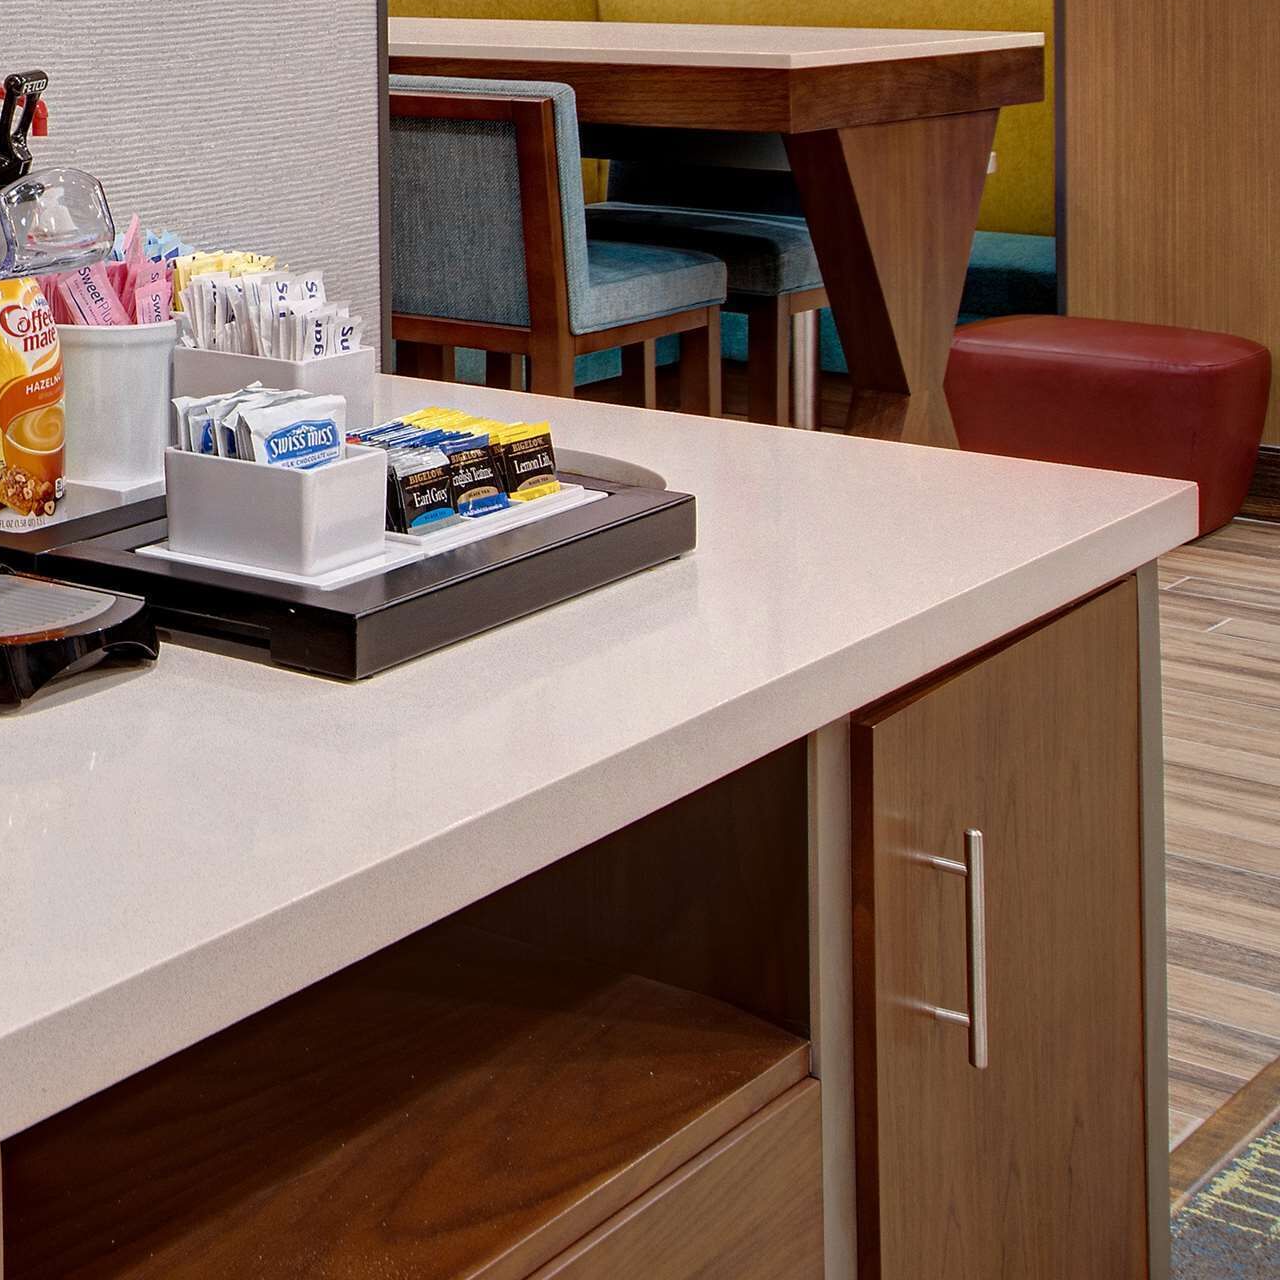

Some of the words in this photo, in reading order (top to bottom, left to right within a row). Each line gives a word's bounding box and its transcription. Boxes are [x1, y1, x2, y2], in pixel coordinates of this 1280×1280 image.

[26, 375, 61, 395] HAZELN
[413, 489, 432, 508] Earl
[431, 487, 448, 503] Grey
